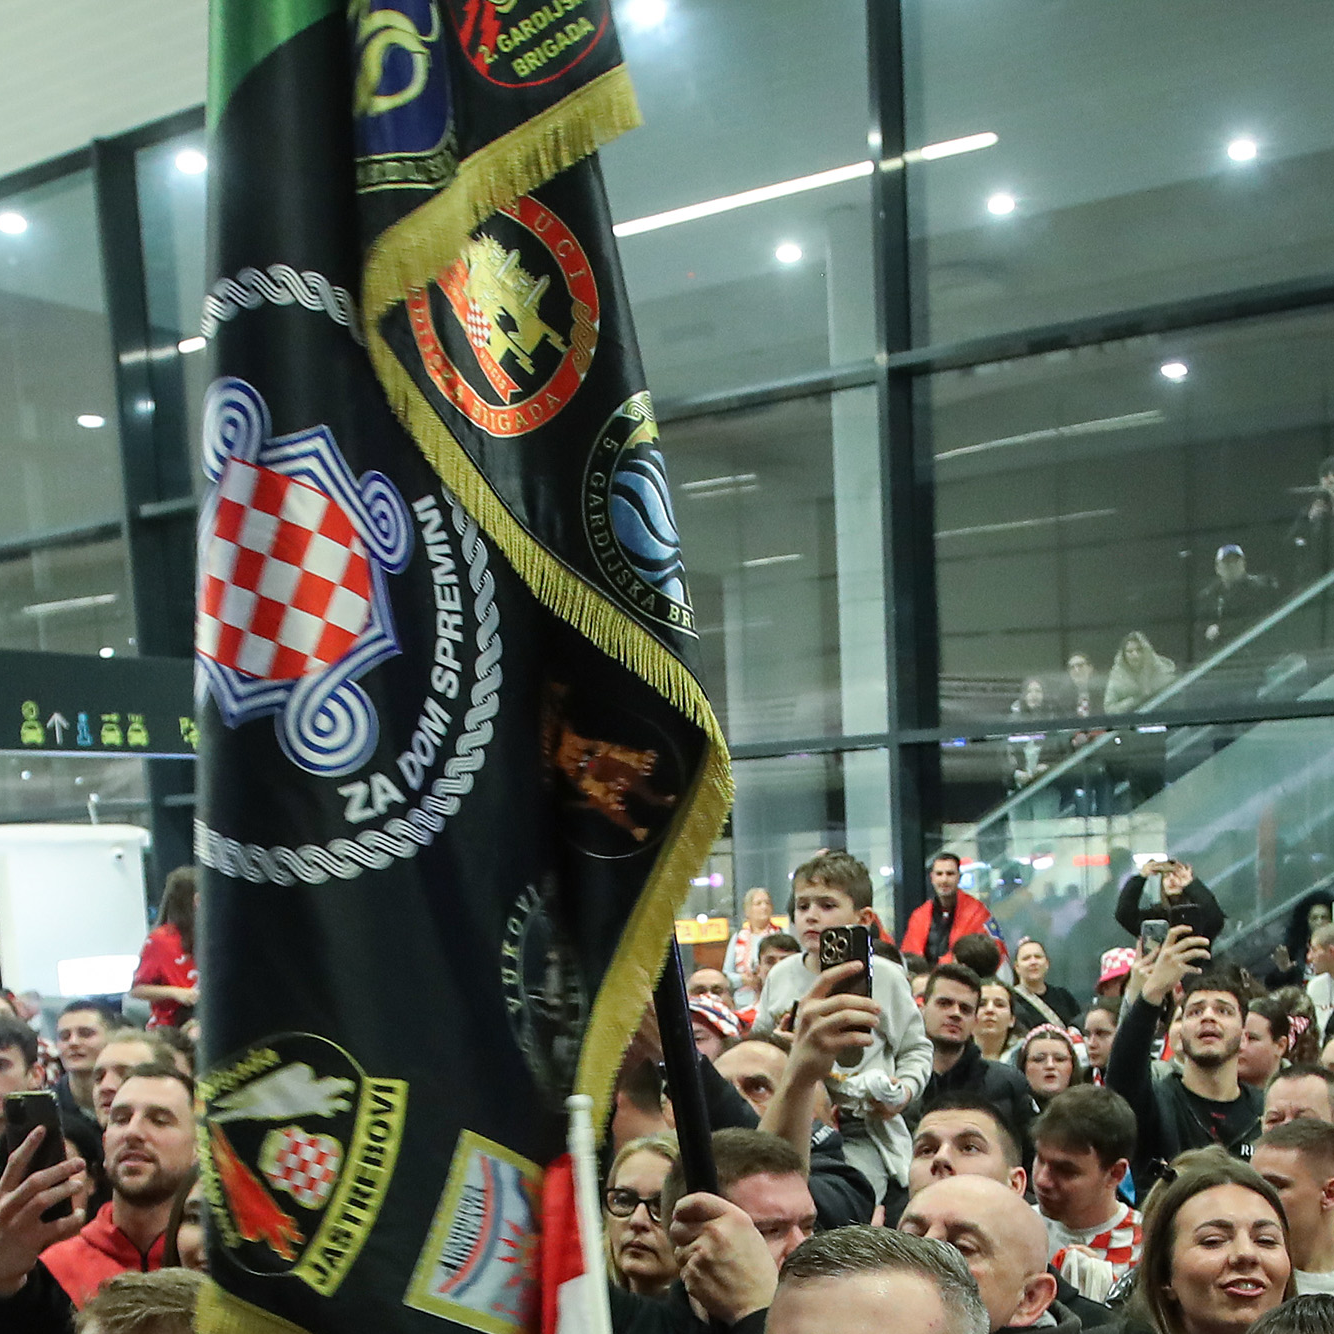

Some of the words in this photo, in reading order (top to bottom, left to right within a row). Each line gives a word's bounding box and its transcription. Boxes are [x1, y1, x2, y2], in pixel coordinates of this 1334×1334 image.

[496, 0, 584, 53] GARDIJS
[511, 17, 595, 77] BRIGADA
[588, 471, 656, 613] GARDIJSKA
[412, 494, 464, 699] SPREMNI
[397, 697, 452, 790] DOM
[337, 771, 407, 824] ZA
